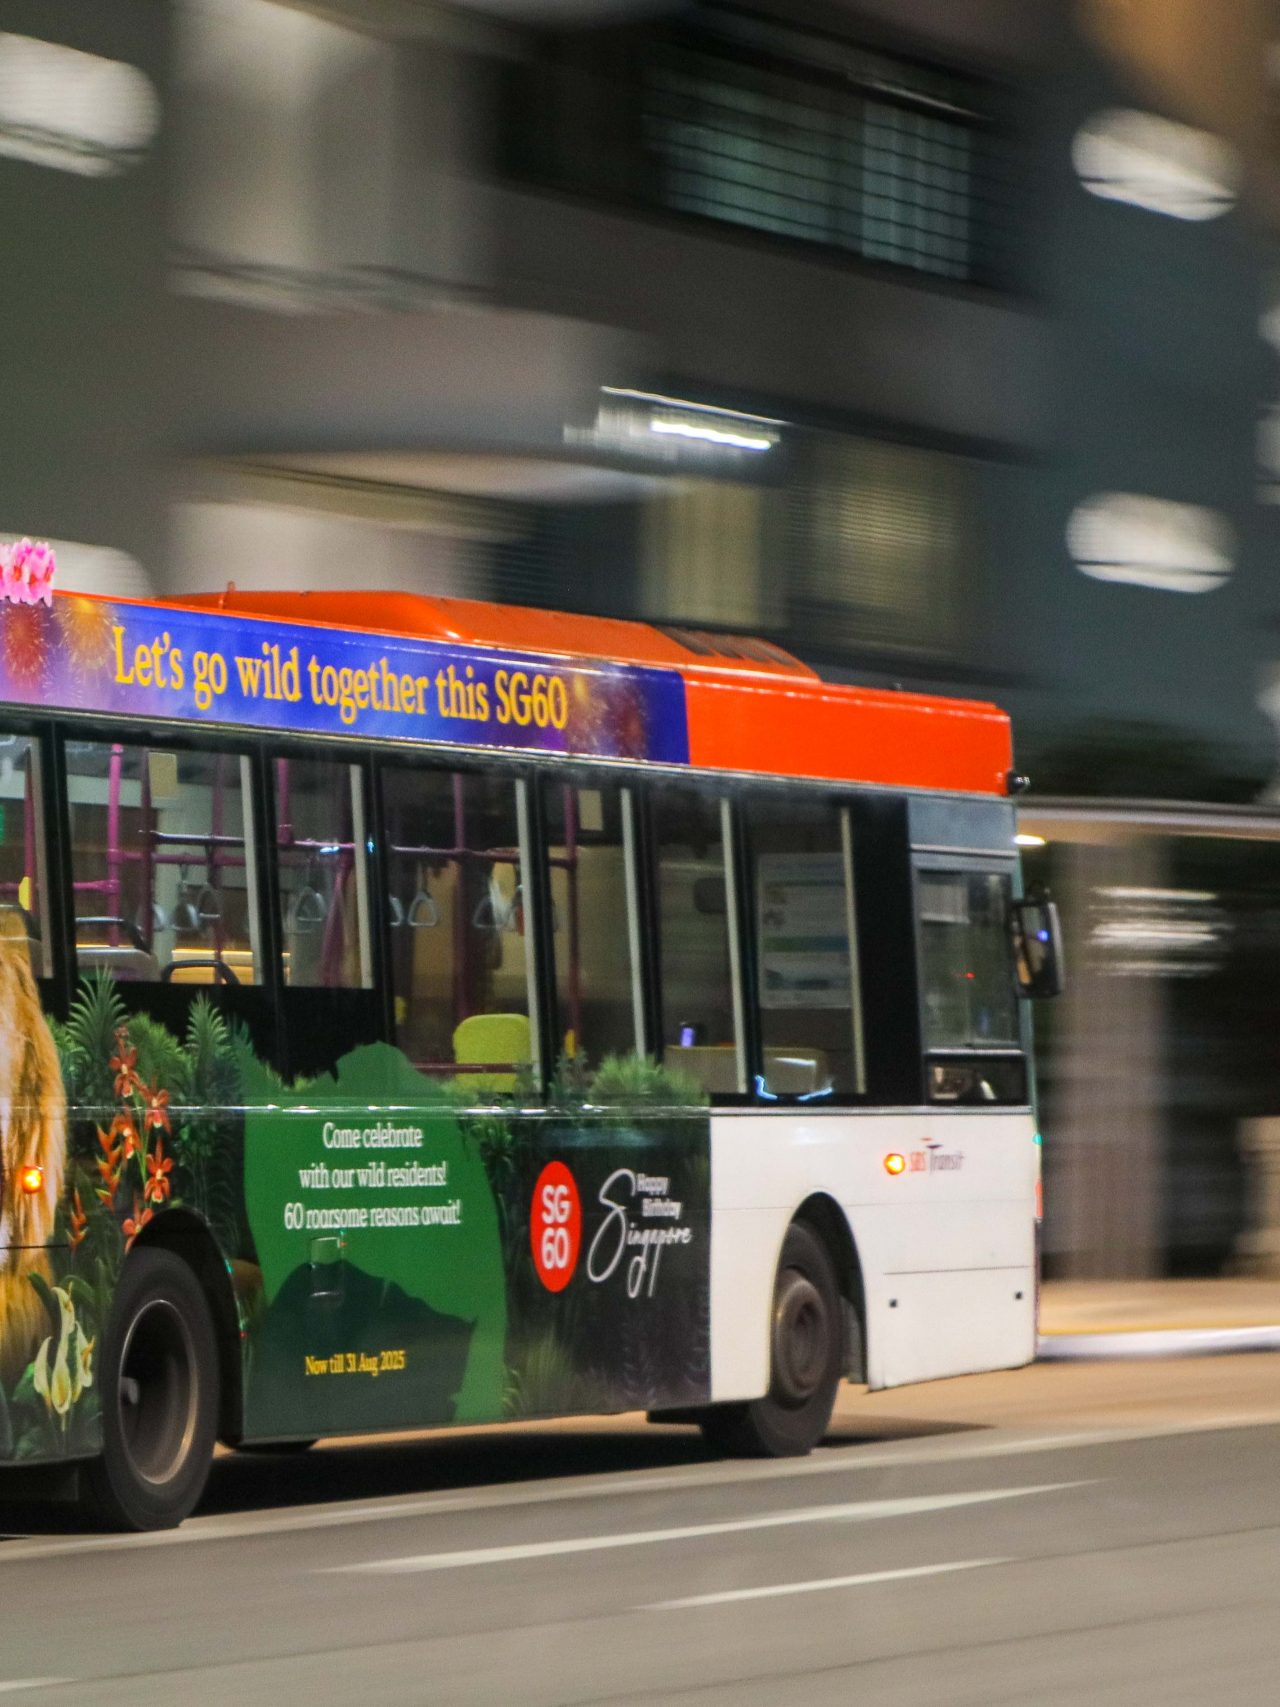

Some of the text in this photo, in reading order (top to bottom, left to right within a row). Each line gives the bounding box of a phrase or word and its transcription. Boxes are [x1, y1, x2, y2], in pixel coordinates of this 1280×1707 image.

[112, 626, 569, 729] Let's go wild together this SG60
[323, 1122, 424, 1148] Come celebrate
[299, 1161, 448, 1188] with our wild residents!
[284, 1199, 462, 1230] 60 roarsome reasons await!
[541, 1184, 571, 1224] SG
[541, 1227, 570, 1269] 60
[305, 1350, 406, 1377] Now till 31 Aug 2025
